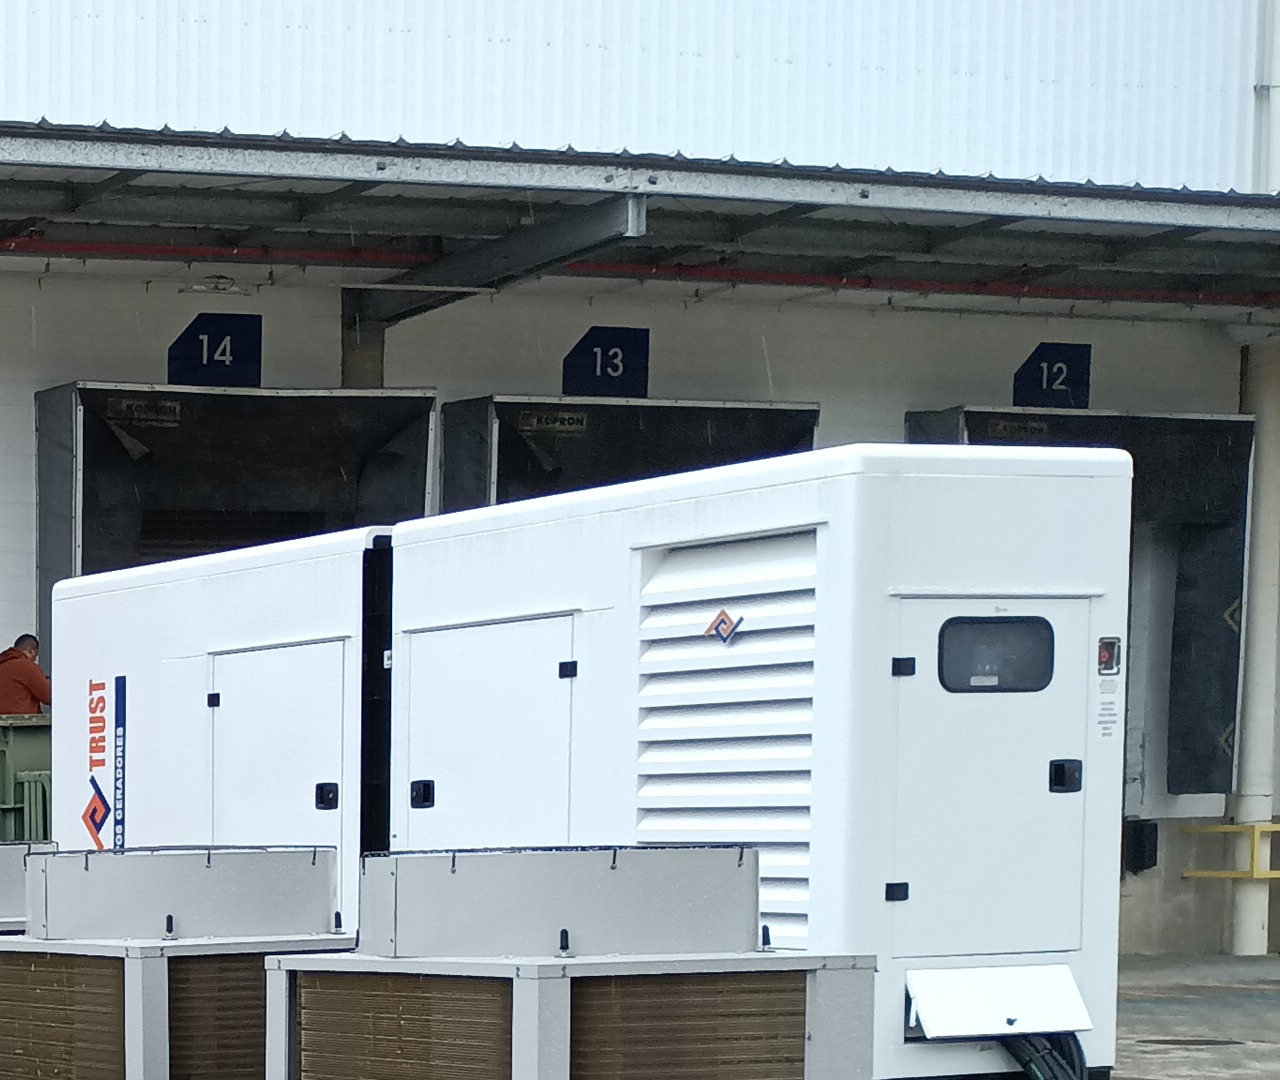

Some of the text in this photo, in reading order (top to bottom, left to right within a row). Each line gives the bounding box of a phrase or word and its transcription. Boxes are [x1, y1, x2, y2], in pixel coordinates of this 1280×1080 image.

[199, 334, 233, 366] 14
[593, 347, 624, 377] 13
[1040, 362, 1067, 389] 12
[89, 679, 106, 773] TRUST
[115, 727, 124, 820] GERADORES
